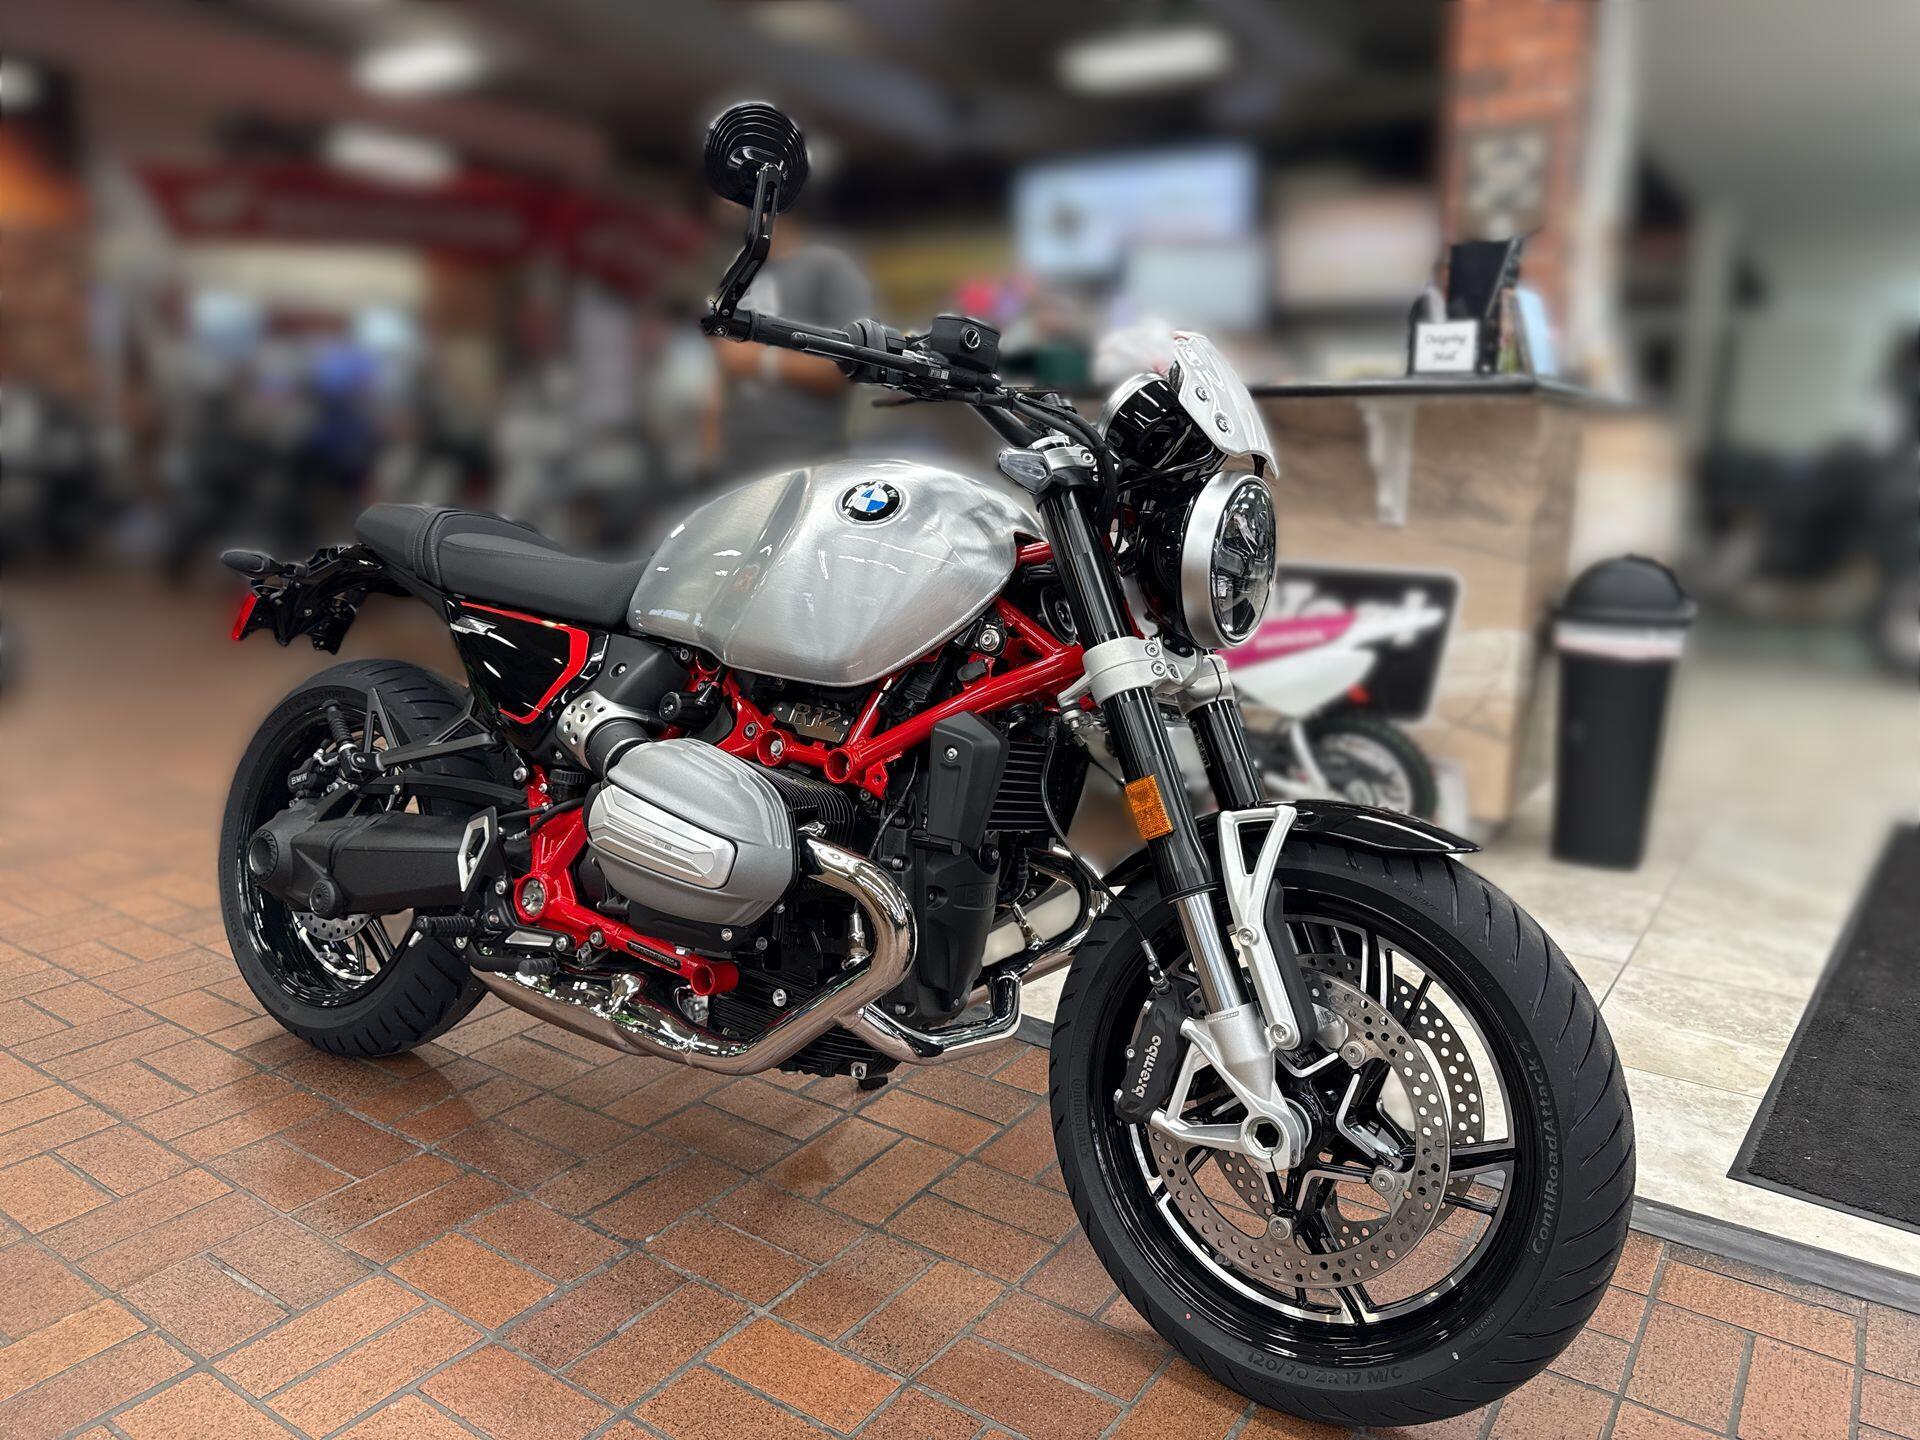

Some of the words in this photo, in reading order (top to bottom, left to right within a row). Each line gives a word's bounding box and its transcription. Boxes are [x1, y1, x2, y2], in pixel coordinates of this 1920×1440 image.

[291, 772, 308, 786] BMW
[1131, 1035, 1162, 1098] brembo
[1528, 1058, 1563, 1255] ContiRoadAttack
[1247, 1351, 1309, 1379] 120/70
[1344, 1371, 1362, 1385] 17
[1368, 1366, 1403, 1384] M/C
